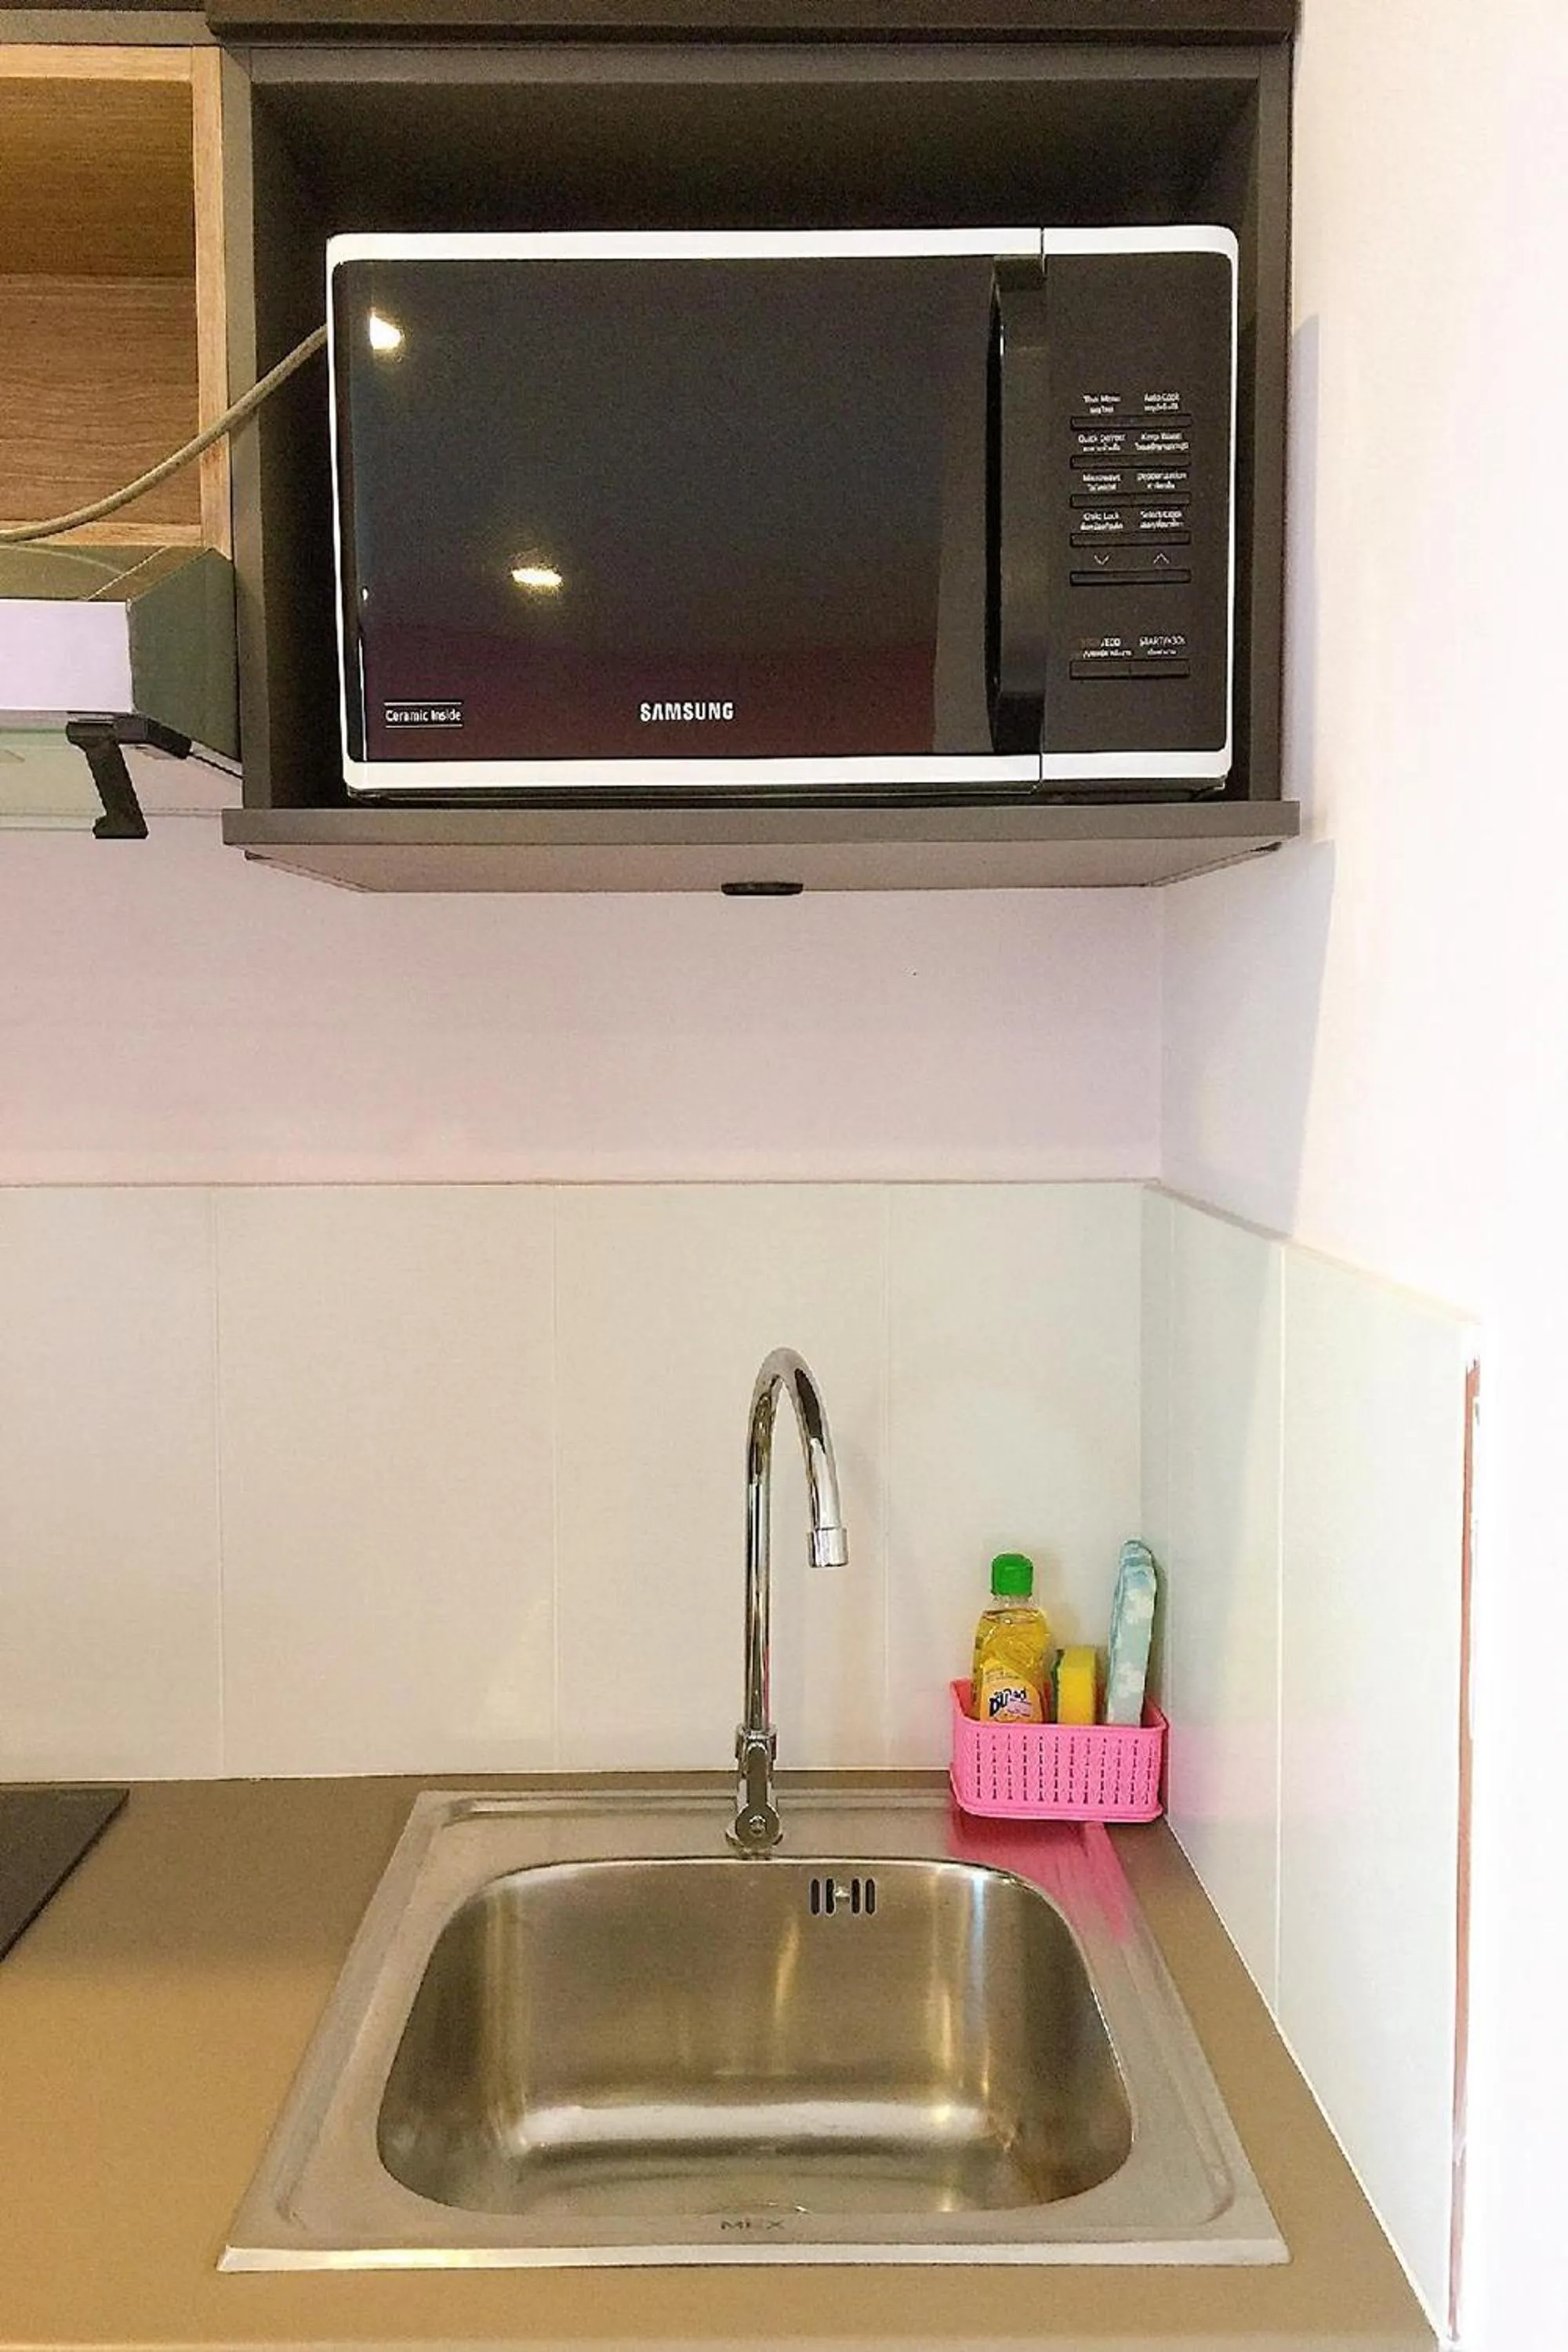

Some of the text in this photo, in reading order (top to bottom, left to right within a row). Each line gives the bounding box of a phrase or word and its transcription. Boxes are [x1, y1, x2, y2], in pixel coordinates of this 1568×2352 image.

[385, 708, 461, 721] Ceramic Inside
[640, 702, 734, 721] SAMSUNG
